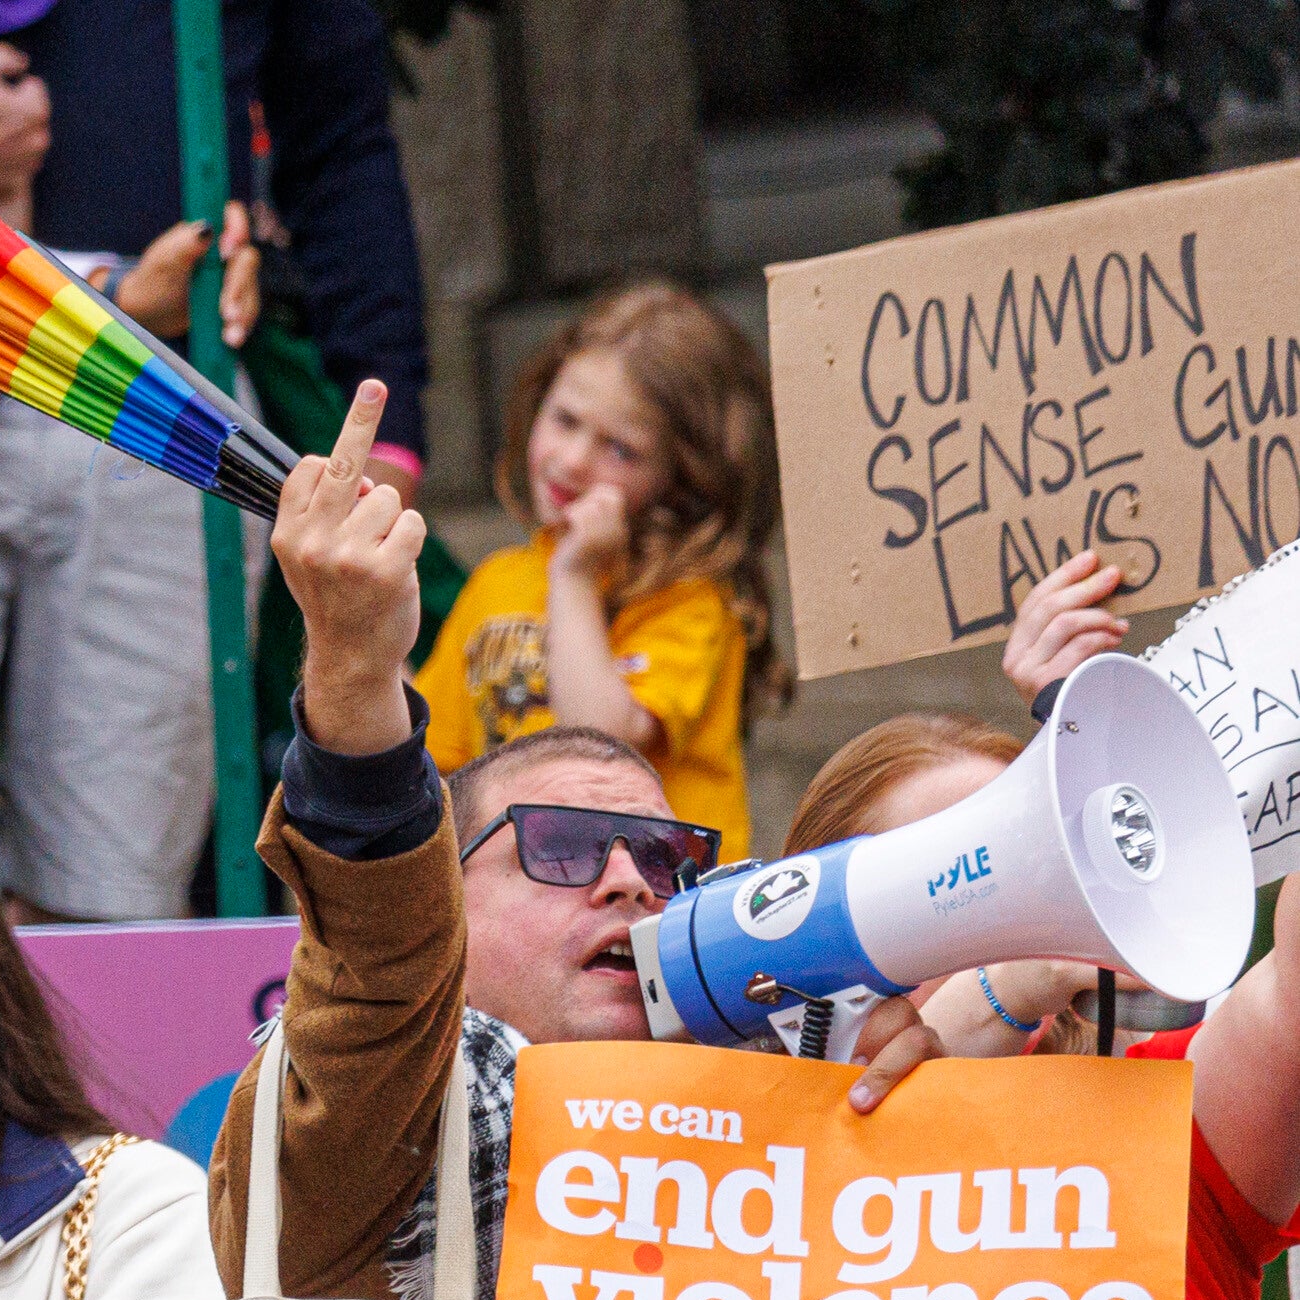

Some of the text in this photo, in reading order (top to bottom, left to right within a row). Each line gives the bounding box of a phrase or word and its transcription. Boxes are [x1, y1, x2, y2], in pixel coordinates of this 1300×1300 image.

[861, 233, 1205, 429] COMMON
[867, 386, 1144, 549] SENSE
[932, 481, 1162, 641] LAWS
[565, 1098, 743, 1143] we can
[535, 1145, 1116, 1282] end gun
